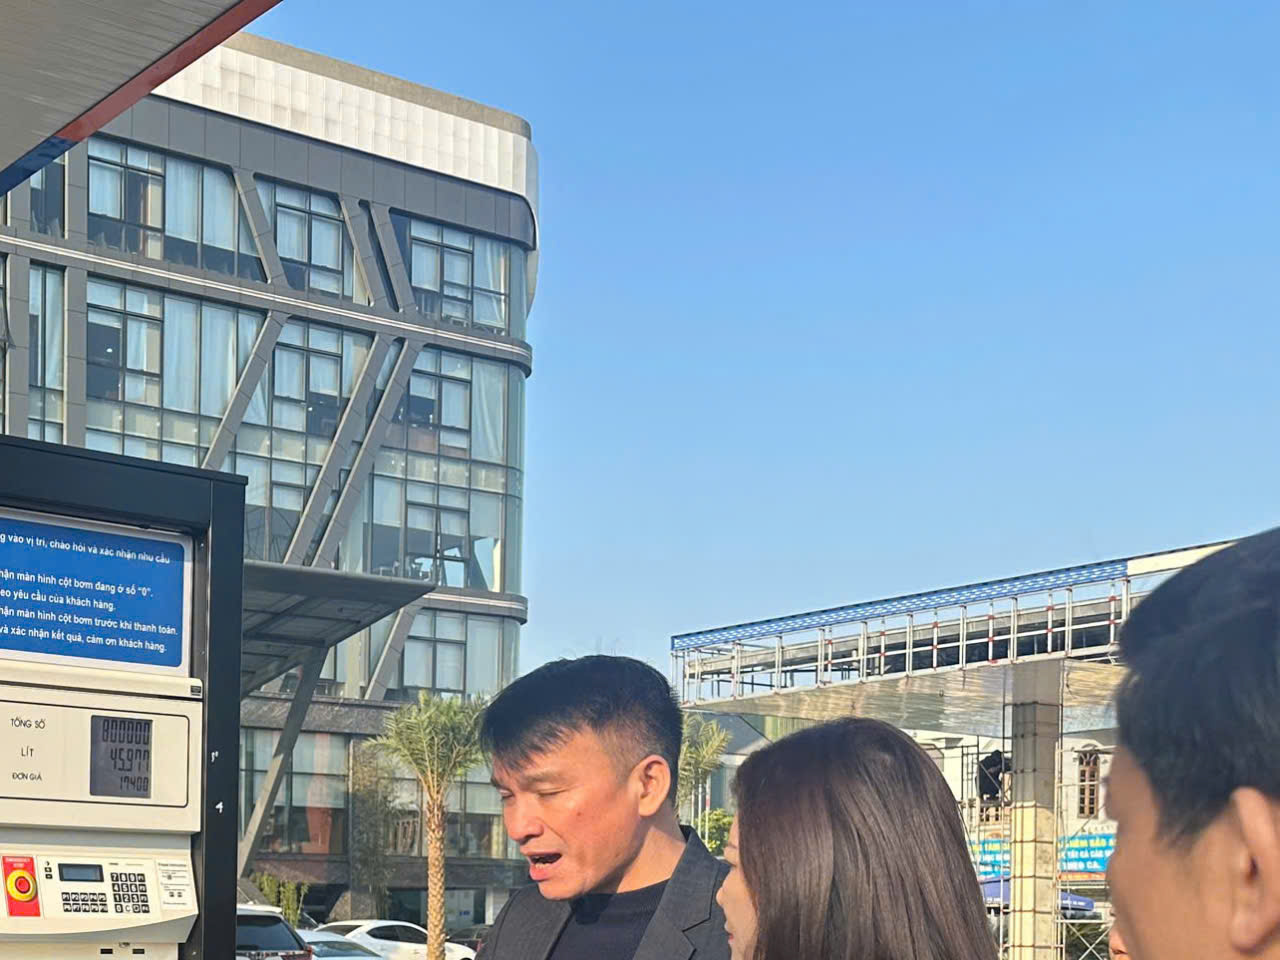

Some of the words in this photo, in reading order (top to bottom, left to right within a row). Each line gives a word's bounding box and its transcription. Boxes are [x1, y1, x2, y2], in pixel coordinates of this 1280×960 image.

[8, 533, 23, 543] vào
[26, 536, 34, 546] vị
[88, 544, 98, 554] và
[17, 572, 35, 582] màn
[38, 574, 56, 584] hình
[58, 576, 72, 588] cột
[74, 578, 93, 590] bơm
[14, 589, 28, 600] yêu
[66, 596, 92, 608] khách
[17, 608, 35, 618] màn
[38, 610, 56, 621] hình
[58, 613, 72, 624] cột
[74, 615, 92, 626] bơm
[120, 620, 132, 630] khi
[134, 622, 156, 633] thanh
[10, 626, 26, 636] xác
[28, 628, 49, 640] nhận
[119, 638, 143, 649] khách
[102, 719, 150, 745] 800000
[21, 745, 34, 757] LÍT
